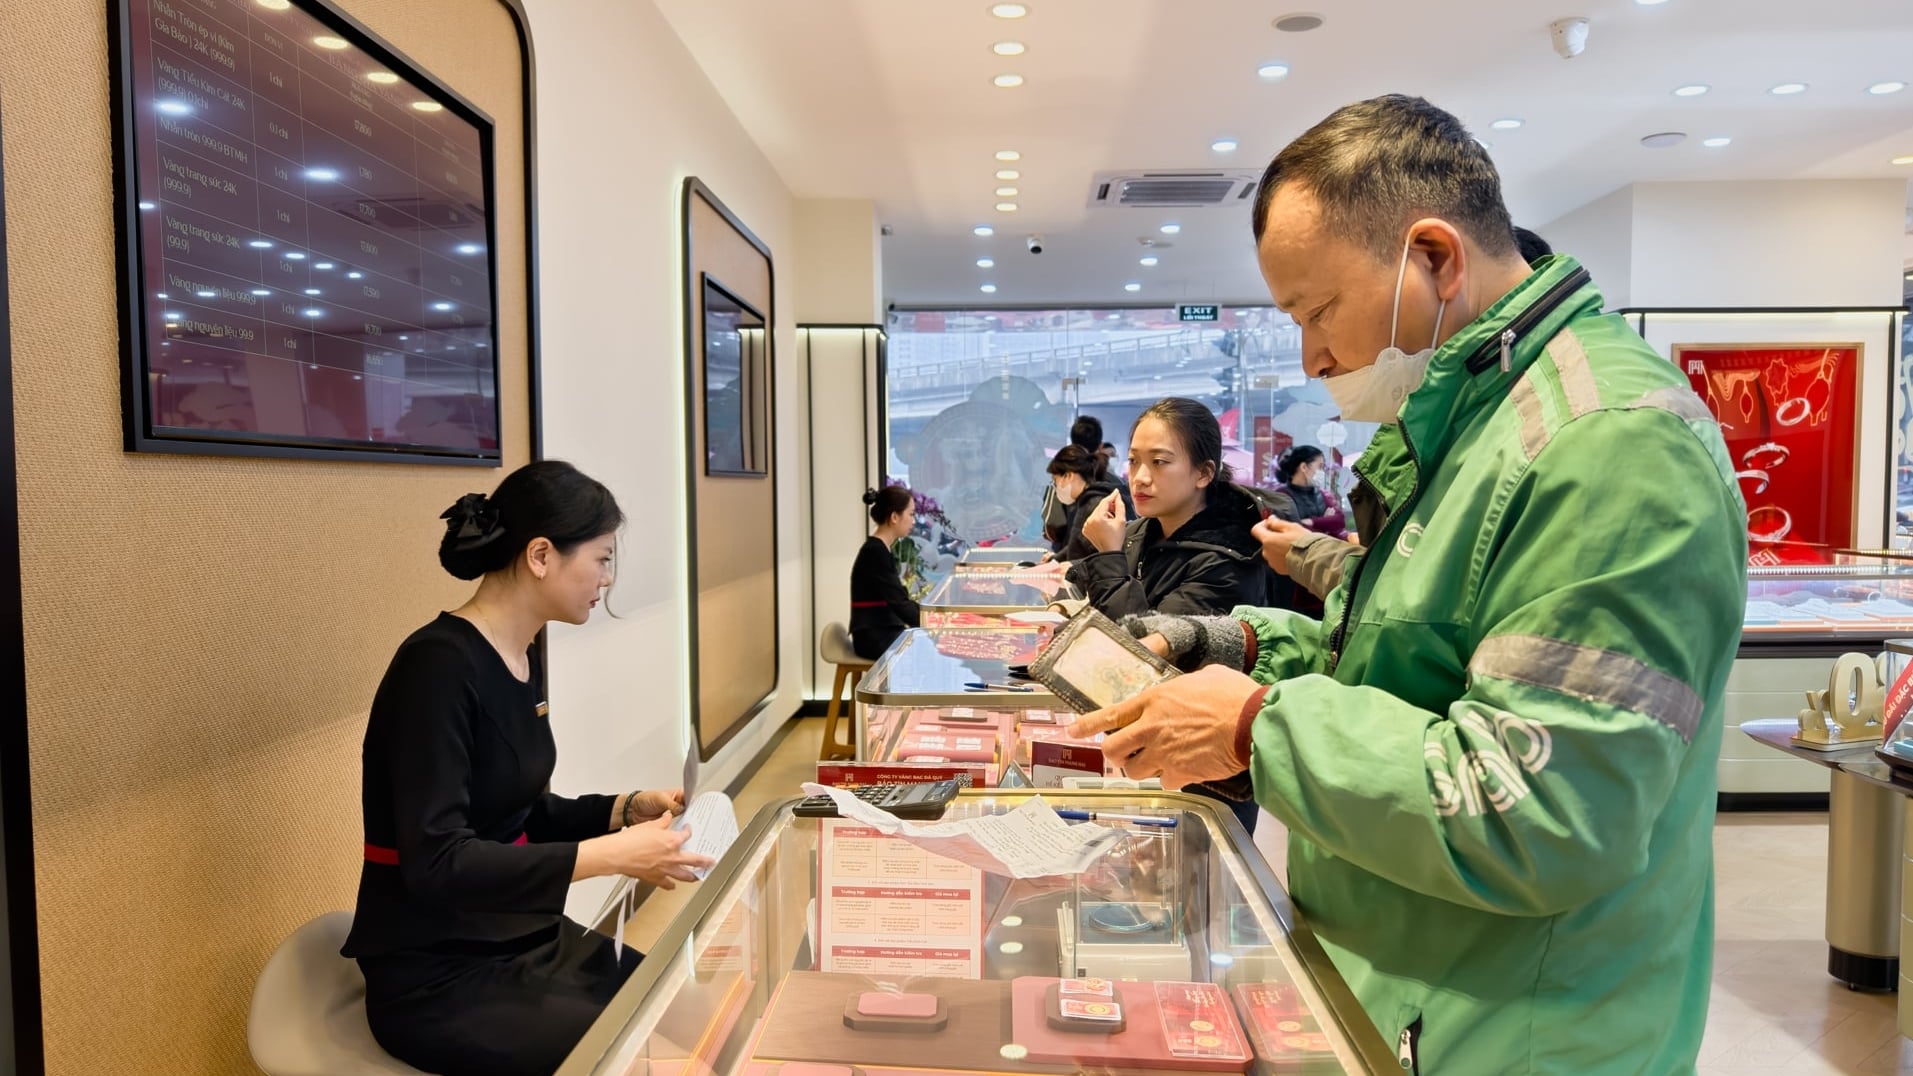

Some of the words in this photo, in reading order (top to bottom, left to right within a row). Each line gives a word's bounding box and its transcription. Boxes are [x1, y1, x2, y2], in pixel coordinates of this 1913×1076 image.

[223, 144, 248, 164] BTMH
[163, 156, 186, 179] Vàng
[186, 165, 208, 187] trang
[166, 215, 188, 236] Vàng
[189, 223, 211, 243] trang
[169, 273, 192, 294] Vàng
[1184, 307, 1213, 315] EXIT
